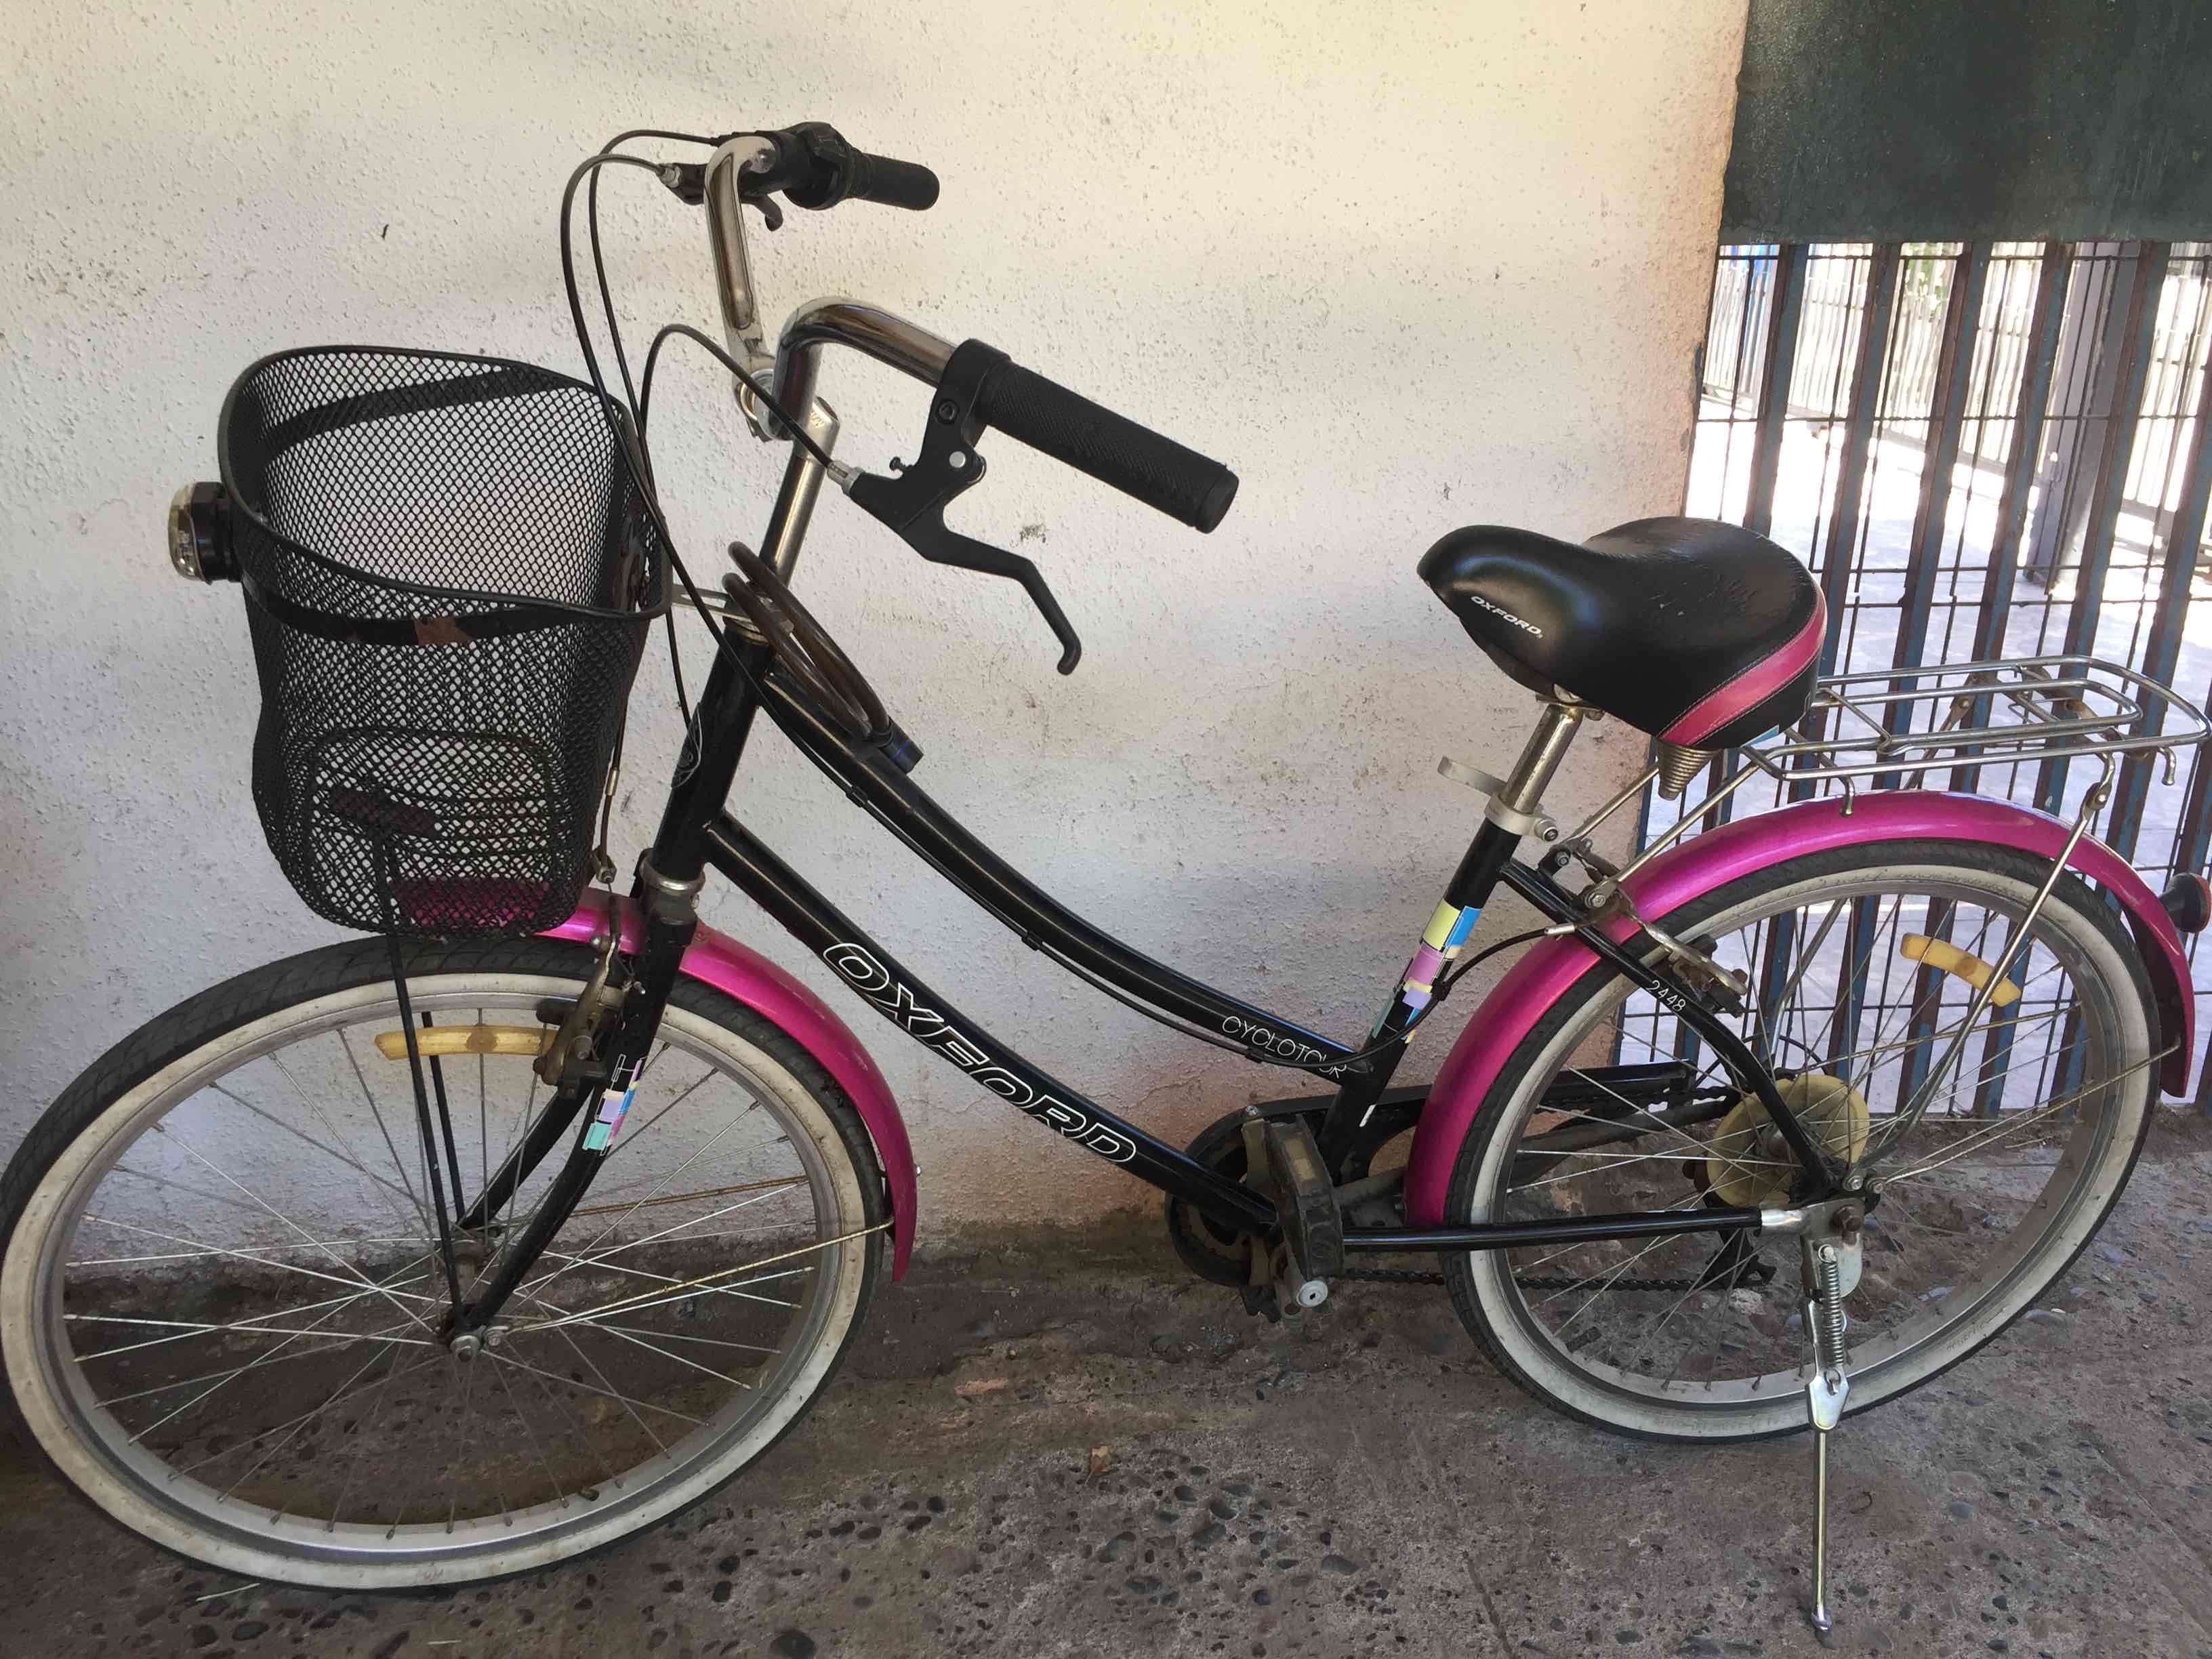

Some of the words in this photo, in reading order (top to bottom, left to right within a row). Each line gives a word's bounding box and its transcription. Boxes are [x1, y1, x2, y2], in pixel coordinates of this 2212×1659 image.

[1471, 595, 1542, 635] OXFORD
[1645, 979, 1687, 1012] 2448
[823, 942, 1136, 1163] OXFORD
